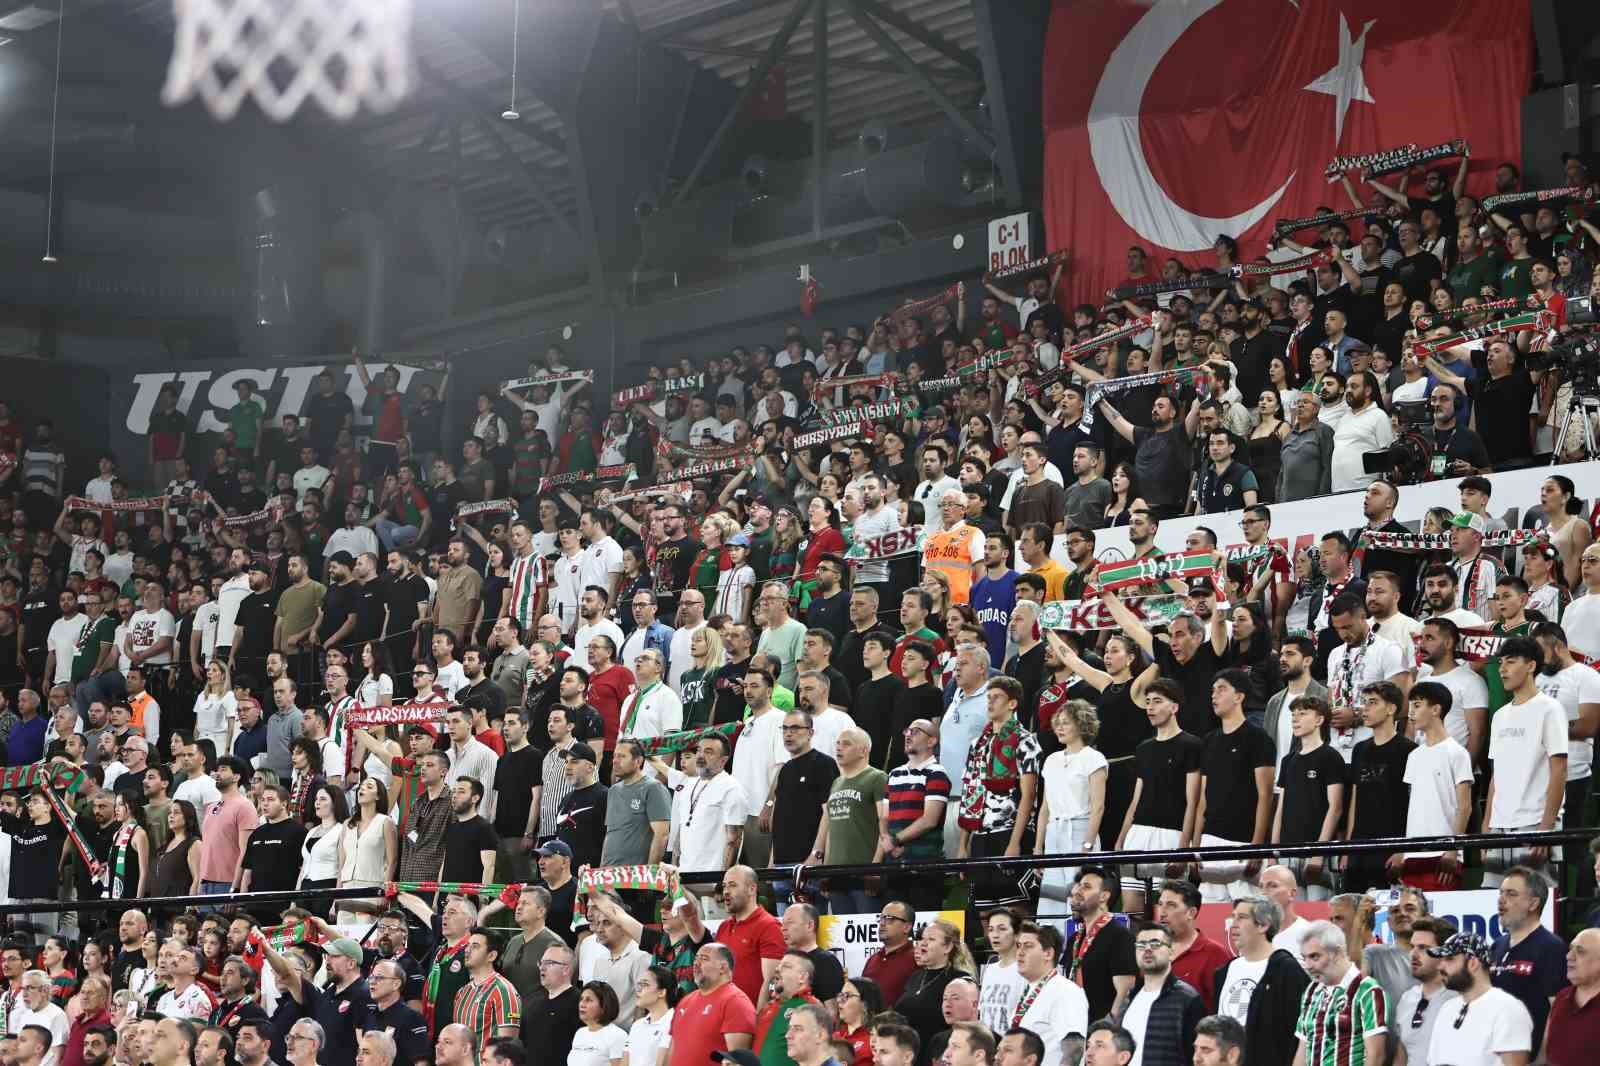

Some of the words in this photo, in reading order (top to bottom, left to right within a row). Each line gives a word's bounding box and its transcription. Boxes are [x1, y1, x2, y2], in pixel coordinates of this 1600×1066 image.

[998, 221, 1020, 245] C-1
[990, 245, 1027, 271] BLOK
[977, 607, 1007, 625] DIDAS
[579, 865, 667, 888] ARSIYAKA
[844, 920, 881, 943] ÖNE
